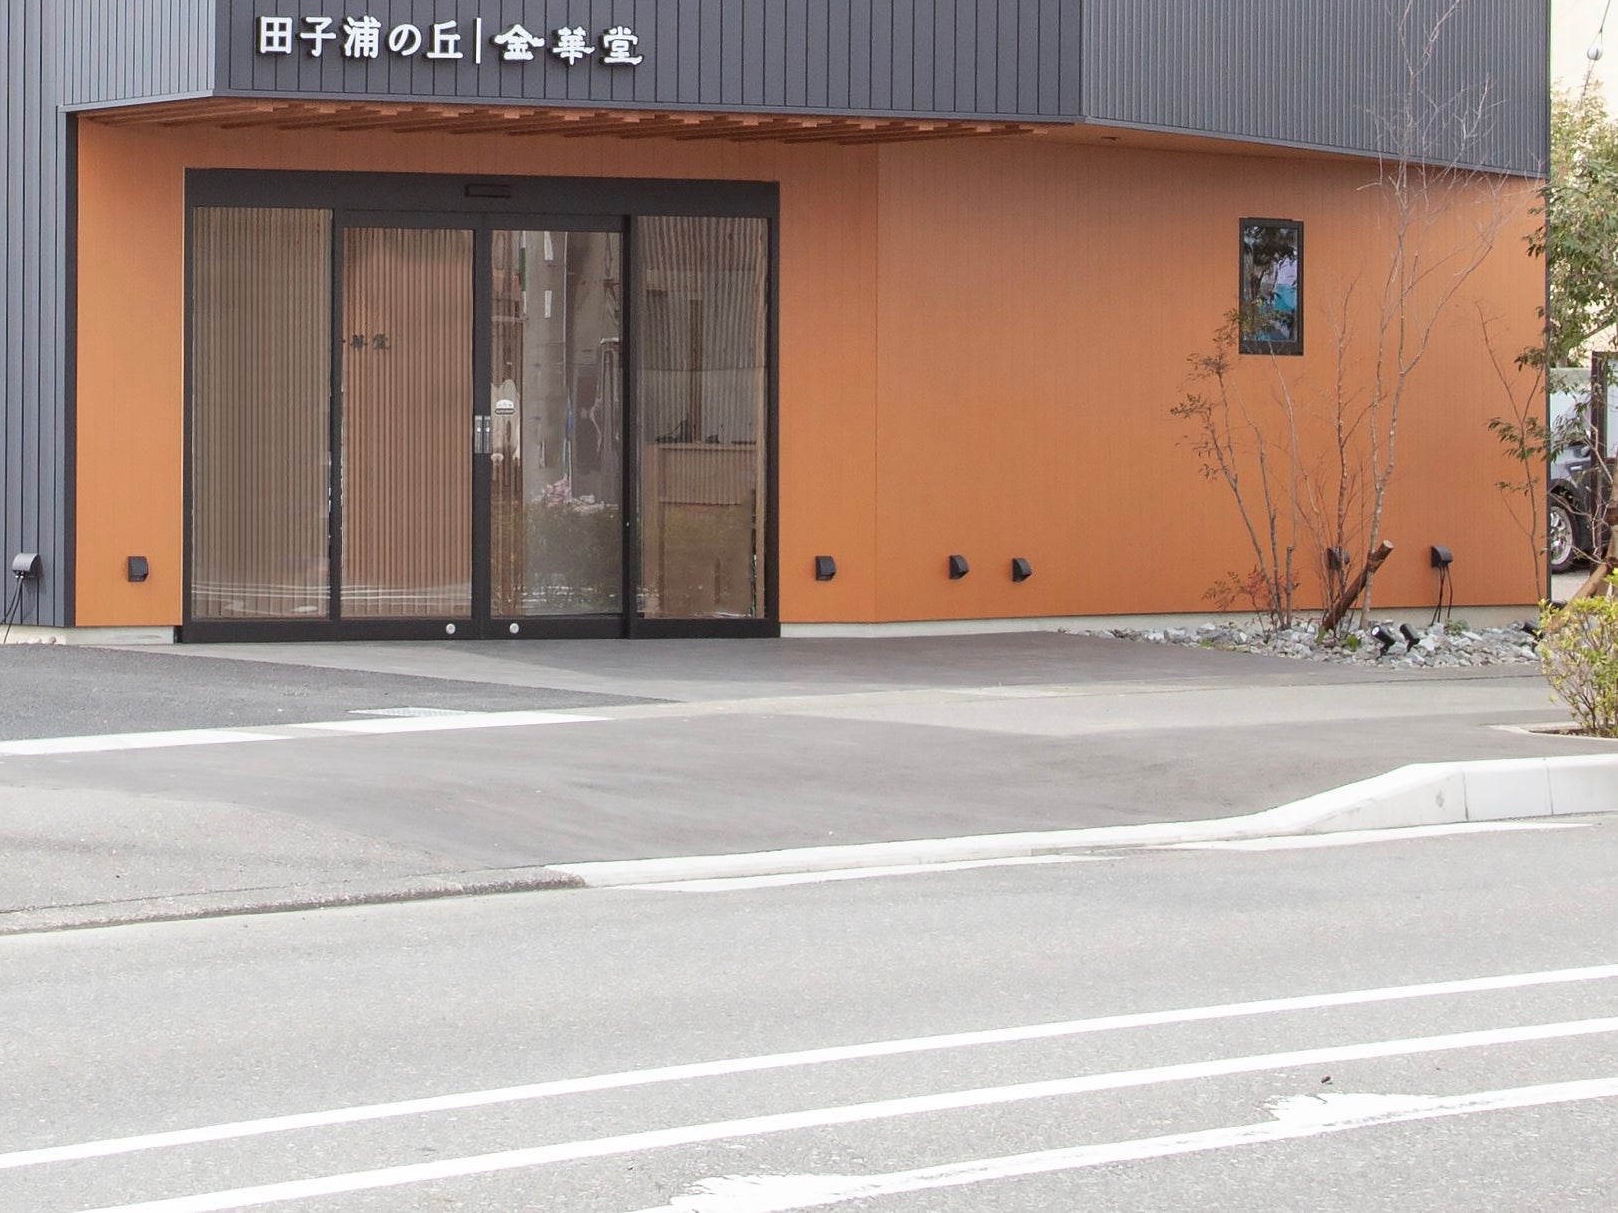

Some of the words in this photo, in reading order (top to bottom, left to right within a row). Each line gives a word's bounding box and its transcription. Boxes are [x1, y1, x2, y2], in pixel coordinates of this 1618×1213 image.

[260, 15, 464, 59] 田子浦の丘
[494, 24, 643, 65] 金華堂
